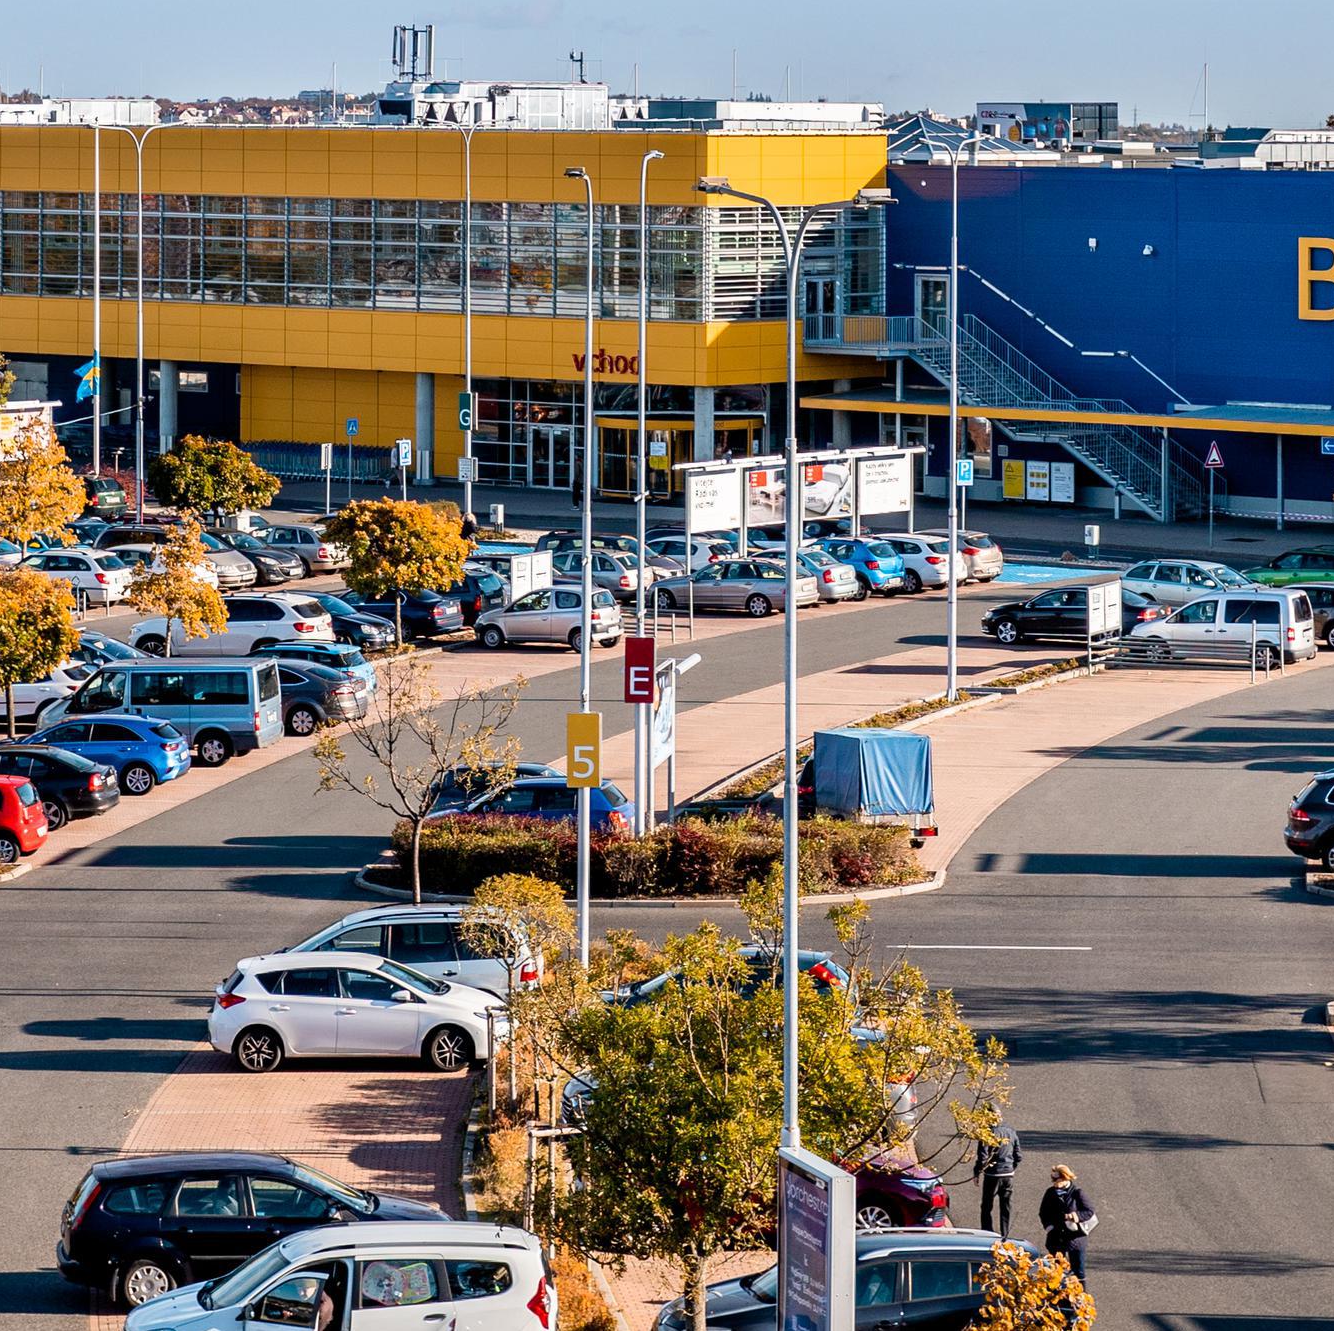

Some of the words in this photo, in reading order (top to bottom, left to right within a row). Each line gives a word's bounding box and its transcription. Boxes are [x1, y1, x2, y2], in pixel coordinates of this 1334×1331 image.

[459, 408, 471, 426] G
[629, 666, 649, 695] E
[572, 745, 595, 778] 5
